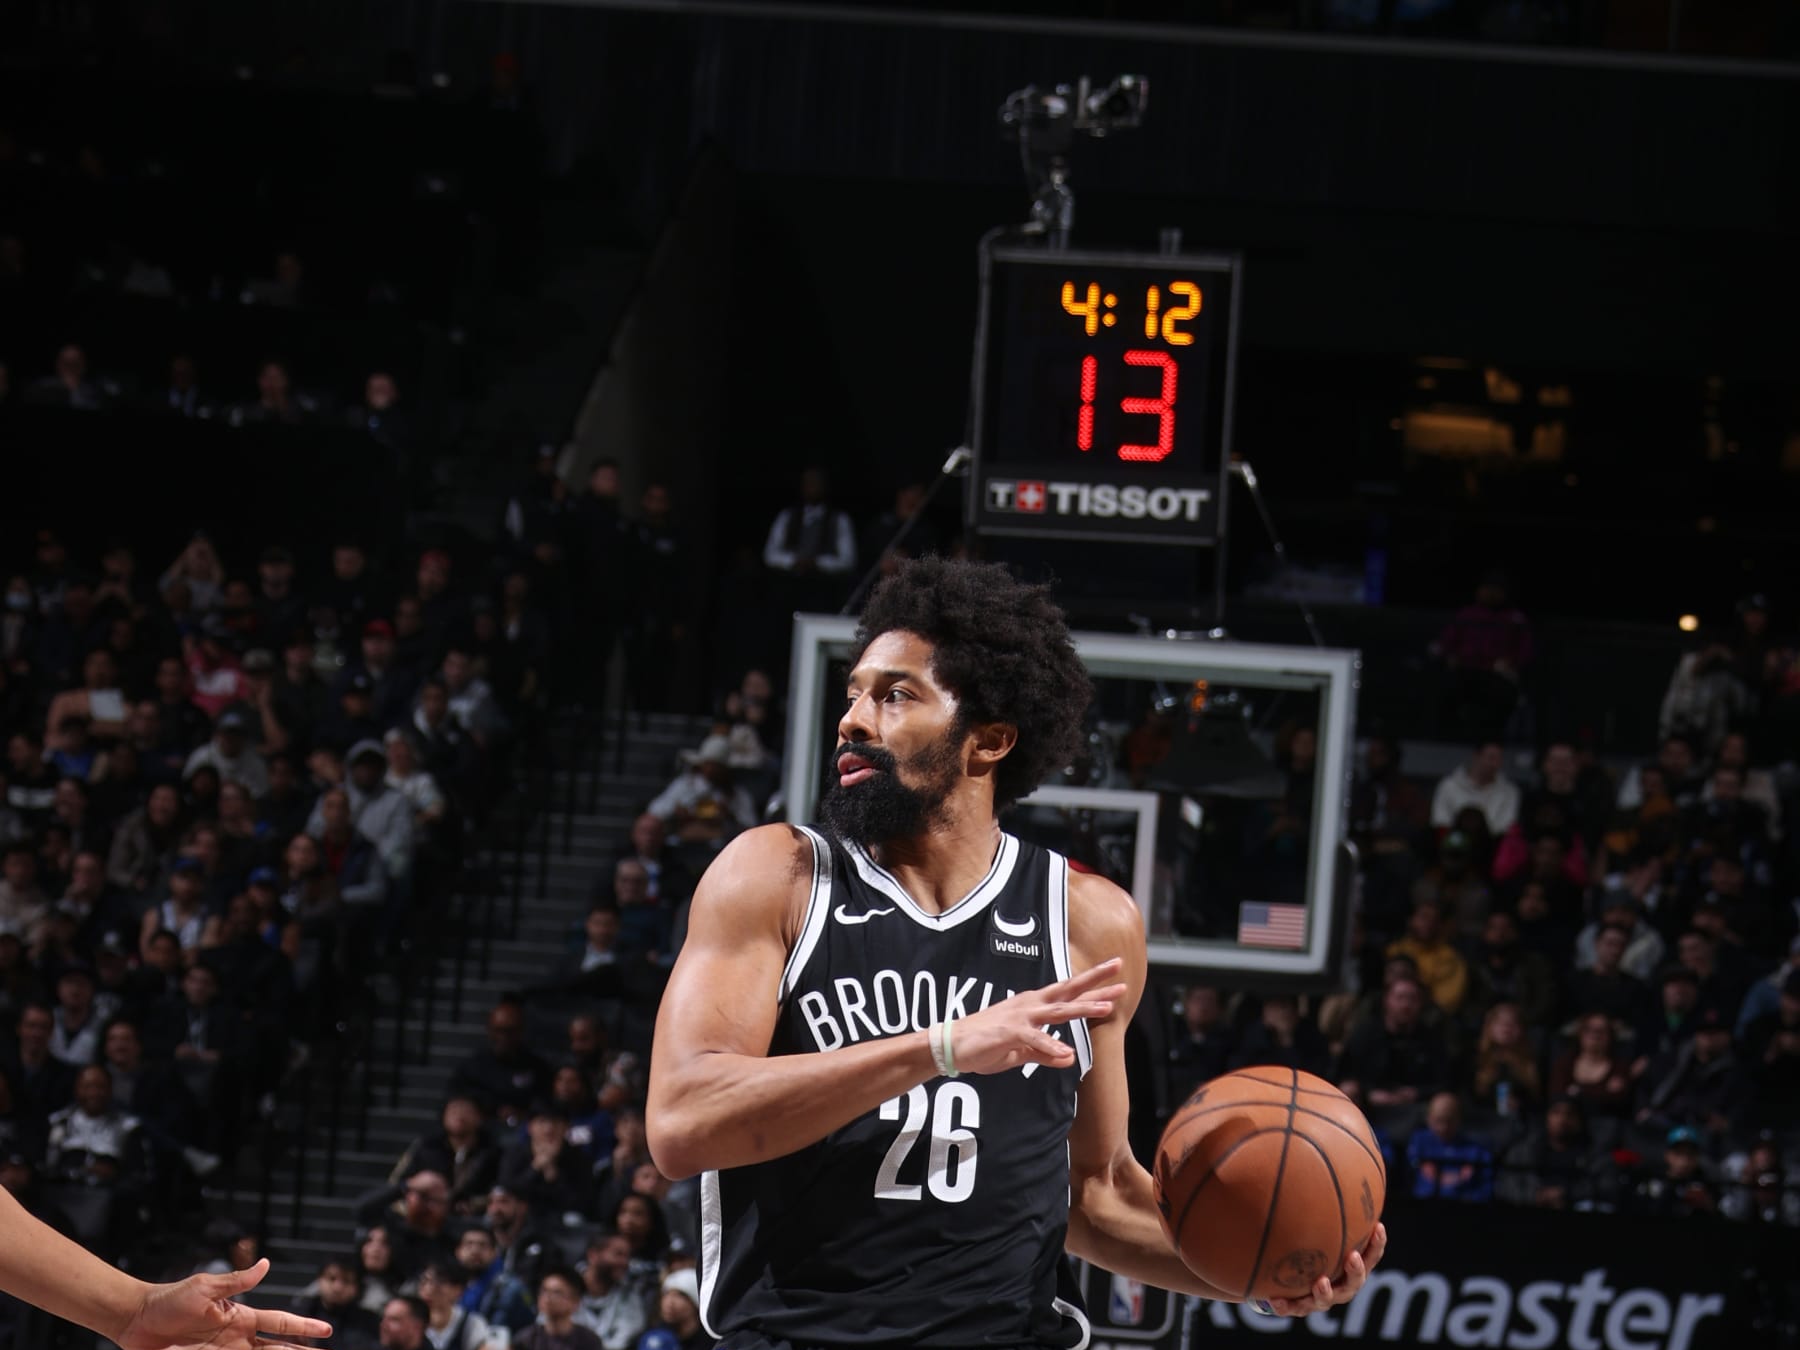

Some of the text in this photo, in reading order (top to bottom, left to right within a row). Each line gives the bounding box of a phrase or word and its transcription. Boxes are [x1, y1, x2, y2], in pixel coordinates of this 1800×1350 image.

[1077, 350, 1178, 462] 13
[1048, 482, 1210, 521] TISSOT
[995, 936, 1040, 958] Webull
[874, 1081, 980, 1203] 26
